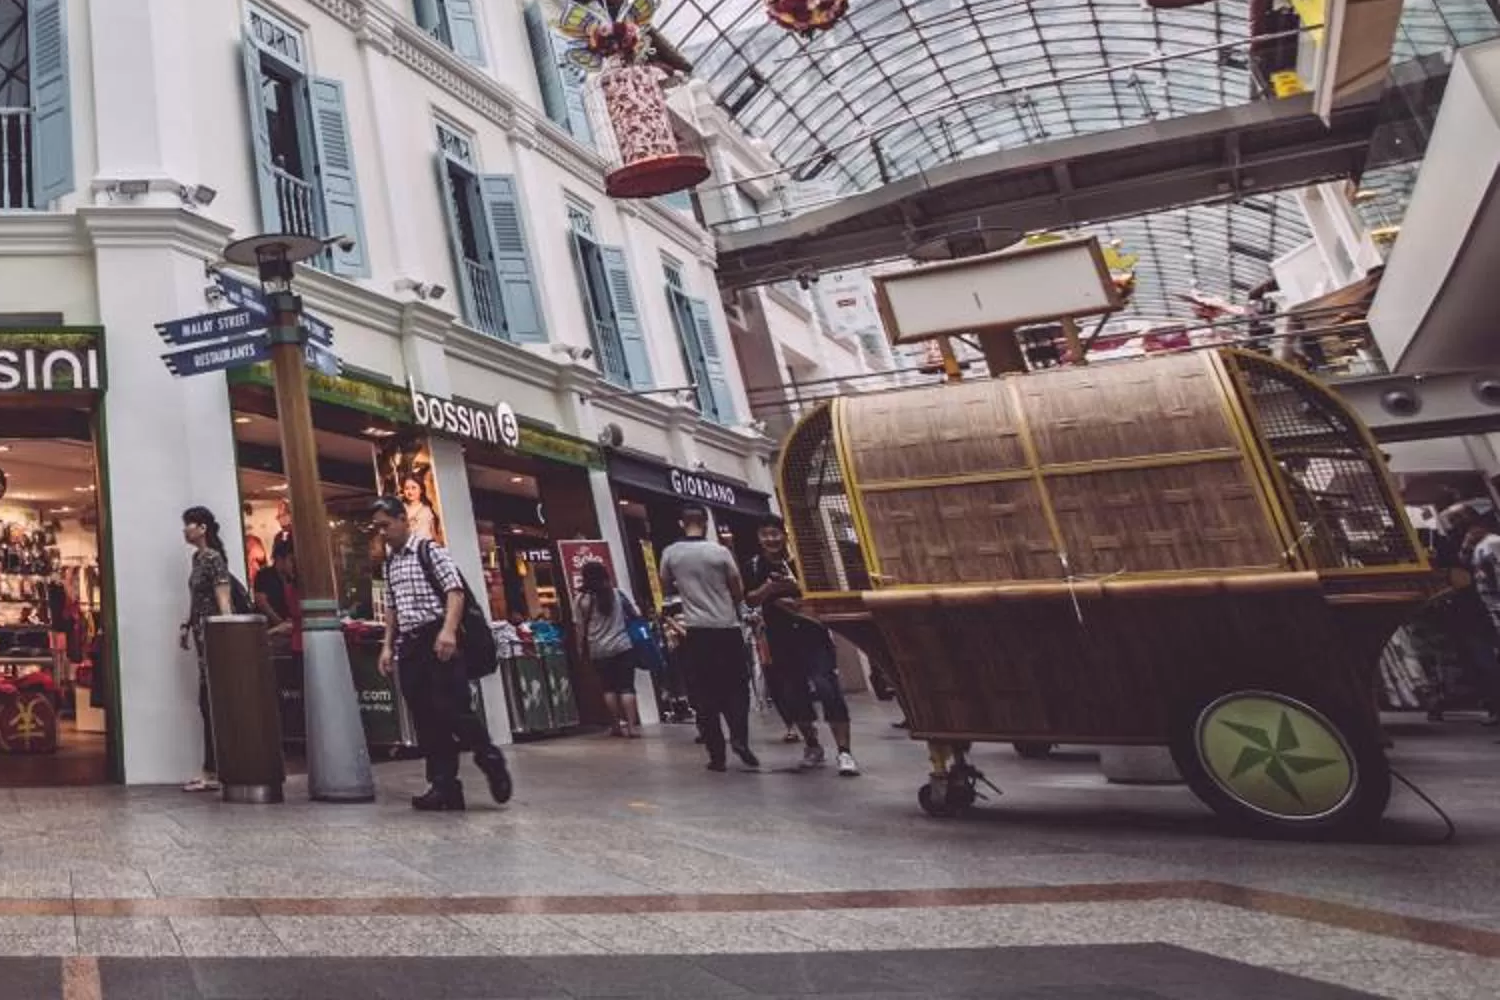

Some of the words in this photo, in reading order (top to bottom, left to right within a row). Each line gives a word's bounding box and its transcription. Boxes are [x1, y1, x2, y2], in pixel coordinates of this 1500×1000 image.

[181, 320, 215, 338] MALAY
[217, 312, 251, 331] STREET
[192, 343, 256, 368] RESTAURANTS
[408, 375, 498, 444] bossini
[671, 469, 736, 506] GIORDANO
